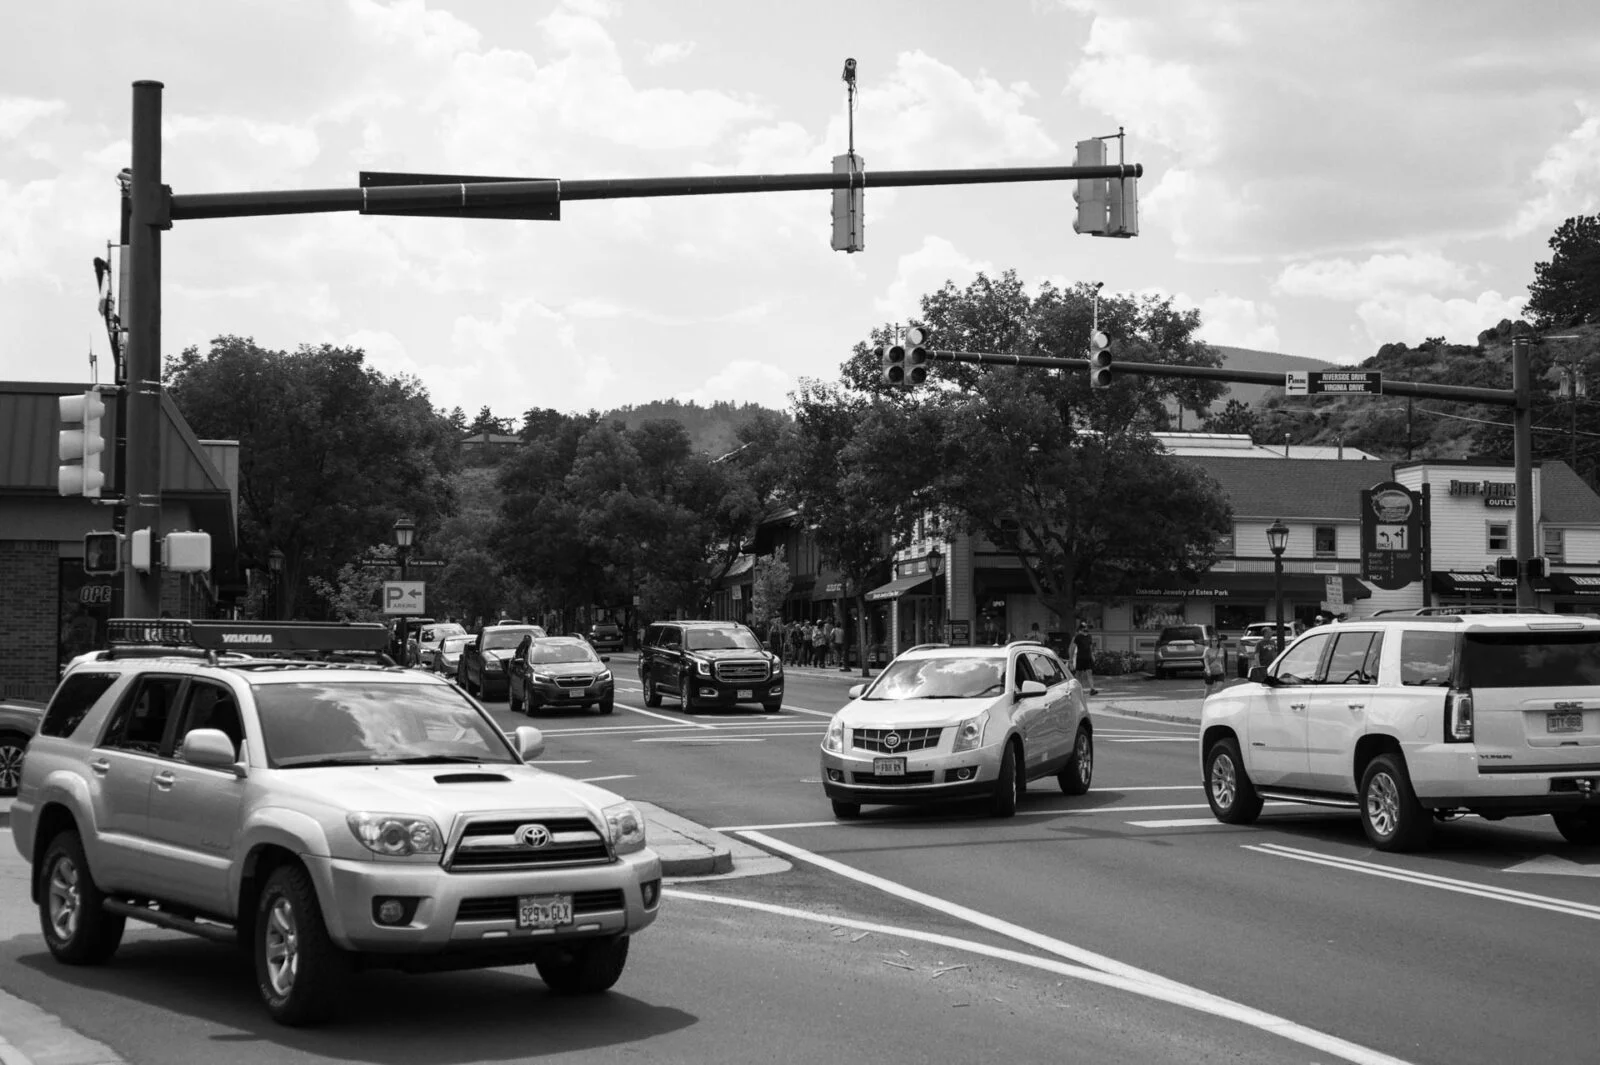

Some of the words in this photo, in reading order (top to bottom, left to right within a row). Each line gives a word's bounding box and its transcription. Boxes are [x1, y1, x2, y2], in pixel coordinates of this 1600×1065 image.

[1350, 373, 1367, 381] DRIVE
[1480, 480, 1516, 496] JERK
[80, 585, 111, 603] OPE
[222, 633, 273, 644] YAKIMA
[1553, 701, 1584, 710] GMC
[522, 907, 539, 922] 529
